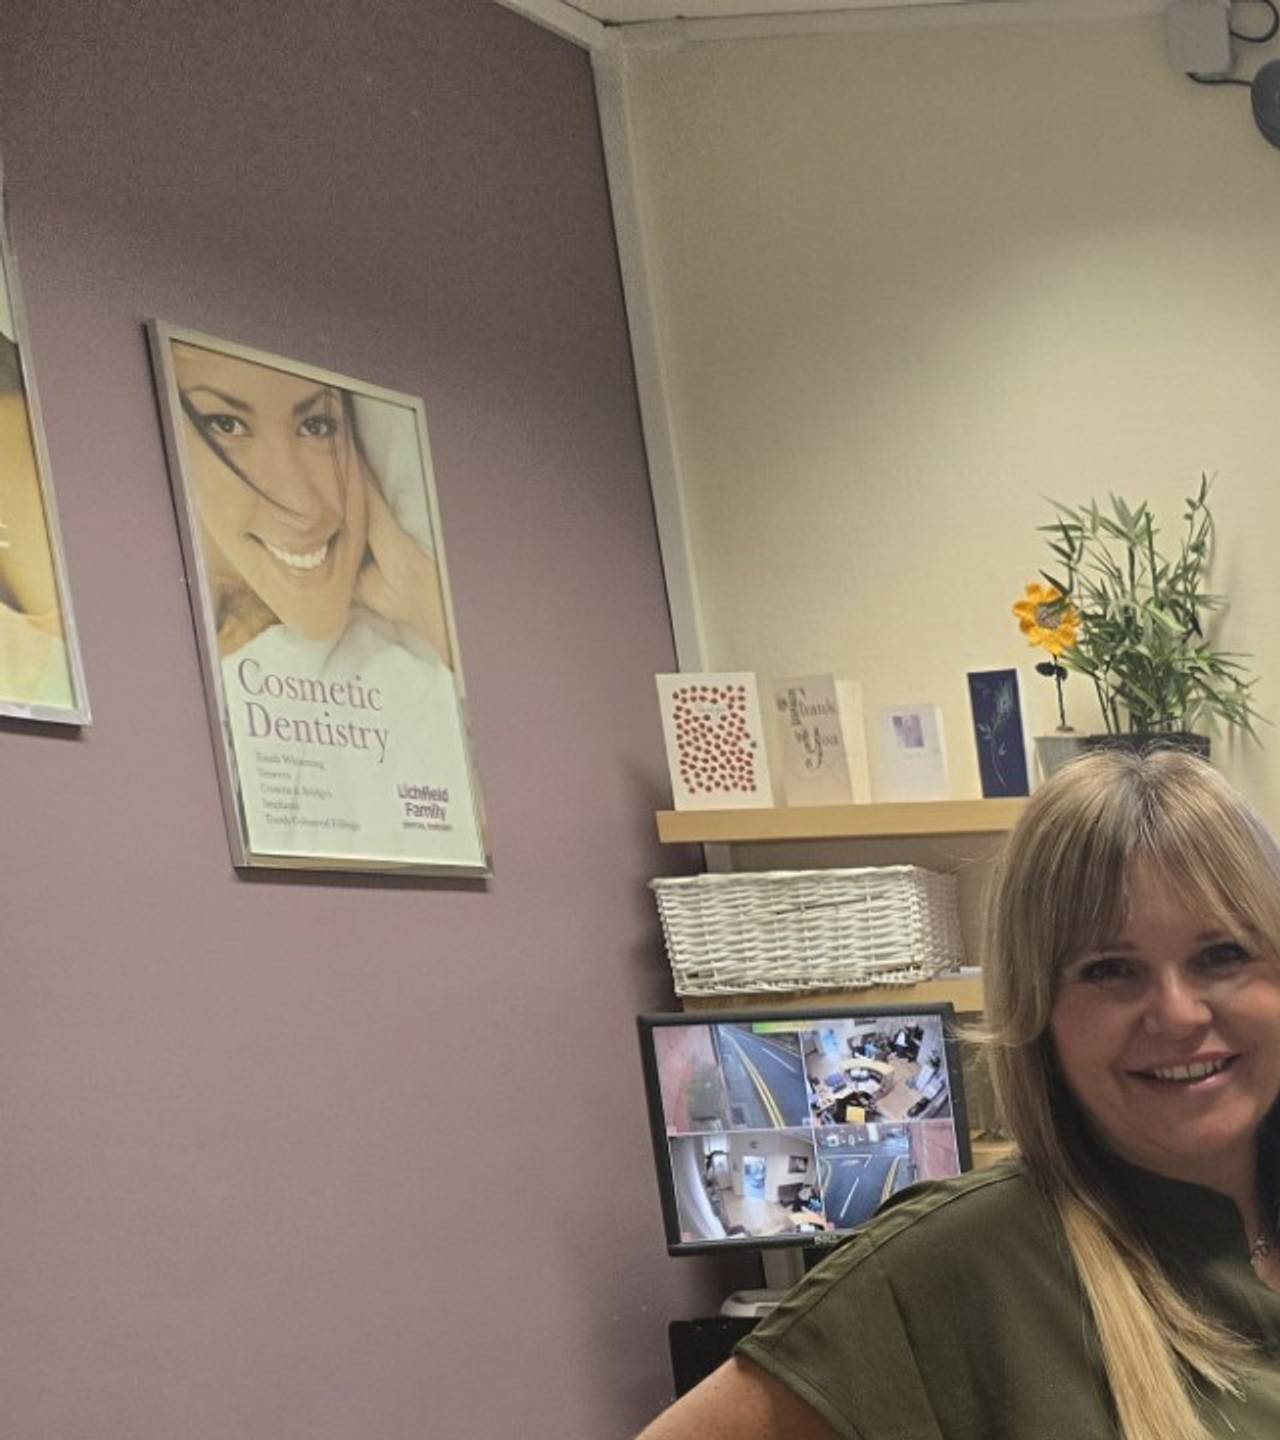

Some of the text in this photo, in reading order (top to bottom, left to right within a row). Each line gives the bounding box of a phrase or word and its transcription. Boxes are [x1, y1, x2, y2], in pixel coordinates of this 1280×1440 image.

[238, 658, 383, 711] Cosmetic
[245, 702, 389, 764] Dentistry
[397, 783, 449, 802] Lichfield
[405, 802, 446, 821] Family
